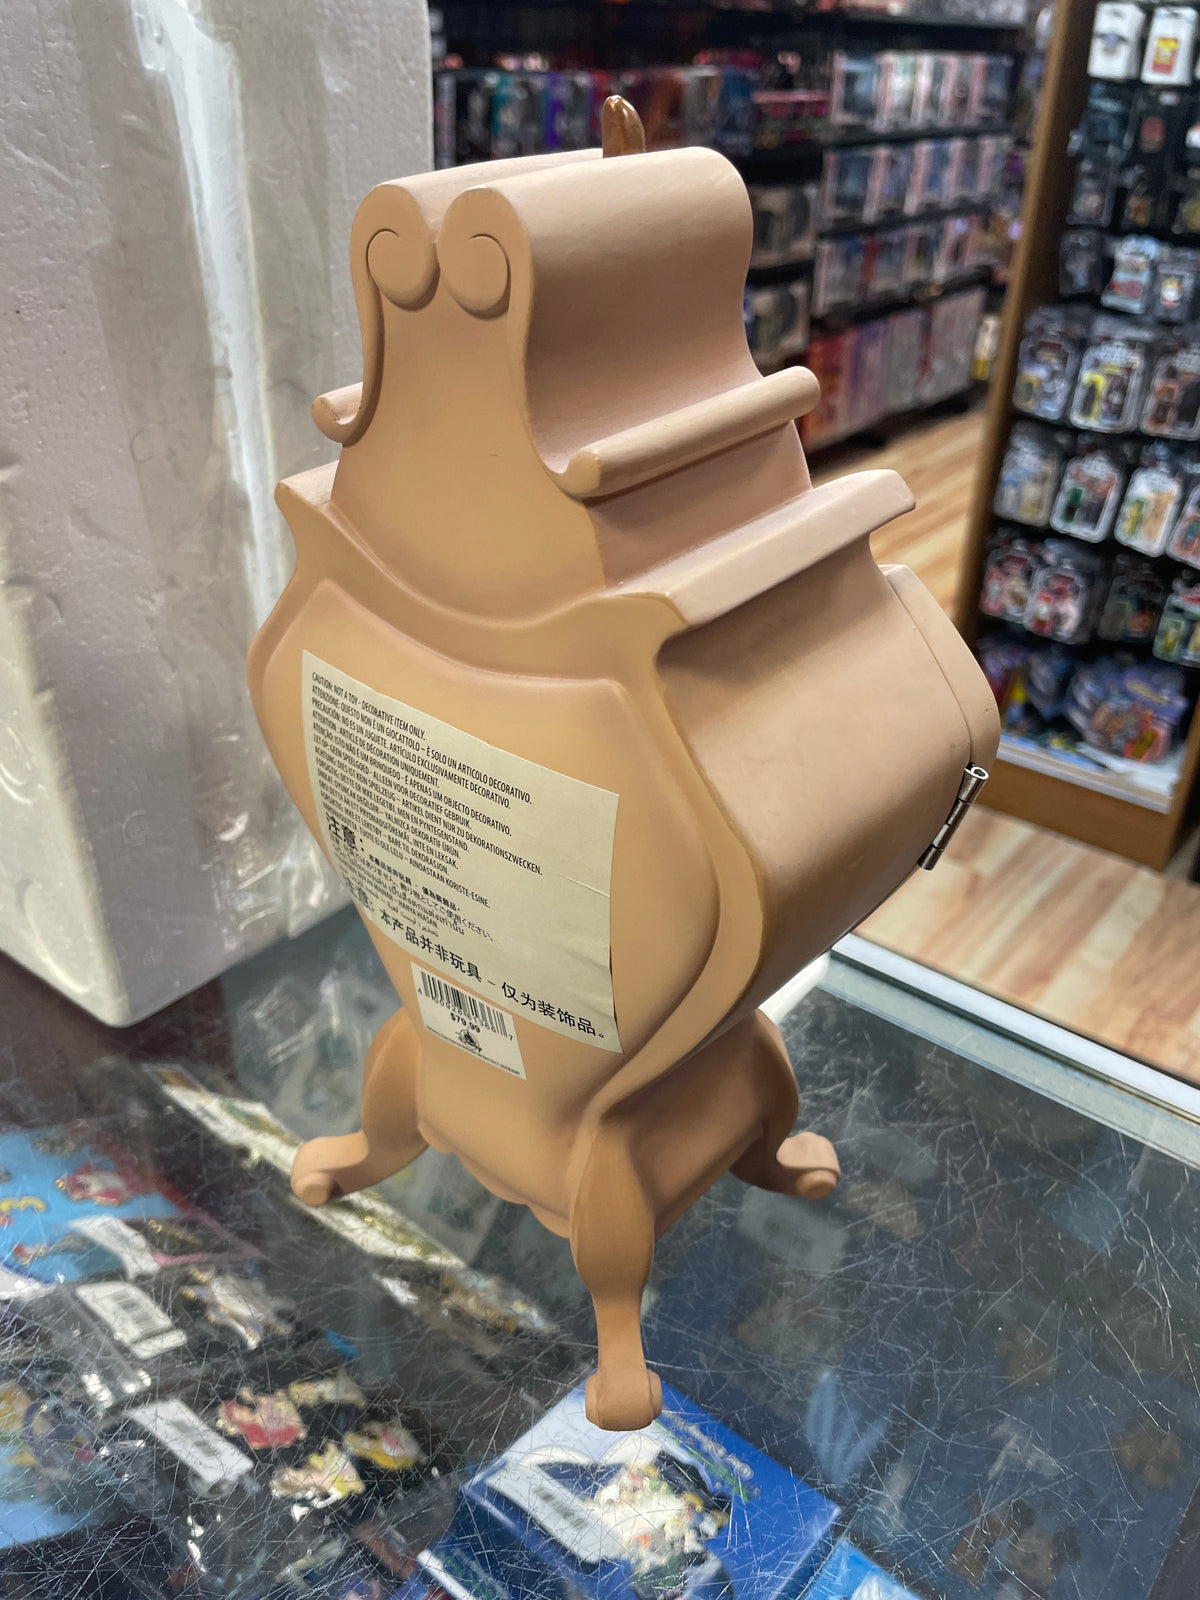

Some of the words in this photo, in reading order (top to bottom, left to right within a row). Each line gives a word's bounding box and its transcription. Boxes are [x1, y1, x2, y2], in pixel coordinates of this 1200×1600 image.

[312, 670, 332, 691] CAUTION:
[334, 683, 343, 697] NOT
[348, 692, 358, 706] TOY
[361, 699, 393, 726] DECORATIVE
[394, 716, 408, 733] ITEM
[408, 723, 425, 740] ONLY.
[312, 683, 339, 709] ATTENZIONE:
[340, 701, 359, 720] QUESTO
[360, 712, 371, 727] NON
[376, 720, 384, 734] UN
[385, 725, 419, 752] GIOCATTOLO
[426, 744, 430, 757] È
[431, 748, 446, 765] SOLO
[447, 756, 456, 770] UN
[457, 760, 487, 784] ARTICOLO
[488, 775, 531, 804] DECORATIVO.
[312, 709, 336, 731] ATTENTION
[339, 725, 358, 745] ARTICLE
[358, 737, 365, 749] DE
[366, 739, 399, 768] DÉCORATION
[400, 759, 439, 788] UNIQUEMENT.
[329, 743, 341, 758] GEEN
[342, 751, 369, 775] SPEELGOED
[373, 770, 392, 788] ALLEEN
[392, 781, 408, 798] VOOR
[409, 789, 442, 814] DECORATIEF
[444, 807, 471, 830] GEBRUIK.
[334, 734, 345, 749] ISTO
[345, 739, 355, 755] NÃO
[360, 751, 368, 763] UM
[369, 756, 400, 781] BRINQUEDO
[405, 774, 408, 785] É
[409, 777, 431, 797] APENAS
[432, 789, 442, 802] UM
[443, 795, 469, 816] OBJECTO
[470, 807, 511, 837] DECORATIVO.
[341, 714, 348, 726] NO
[349, 719, 355, 730] ES
[356, 723, 363, 735] UN
[364, 727, 387, 748] JUGUETE.
[389, 739, 416, 764] ARTÍCULO
[417, 755, 468, 789] EXCLUSIVAMENTE
[469, 781, 510, 809] DECORATIVO.
[329, 786, 342, 801] DETTA
[350, 800, 358, 811] ETT
[412, 837, 425, 852] INTE
[426, 845, 433, 856] EN
[434, 849, 458, 869] LEKSAK.
[337, 759, 348, 773] DIES
[356, 771, 367, 785] KEIN
[368, 778, 395, 802] SPIELZEUG
[401, 797, 424, 817] ARTIKEL
[425, 809, 441, 826] DIENT
[442, 818, 455, 833] NUR
[456, 826, 464, 838] ZU
[465, 830, 542, 876] DEKORATIONSZWECKEN.
[340, 772, 354, 788] DETTE
[355, 782, 361, 792] ER
[362, 786, 372, 800] IKKE
[397, 806, 409, 821] MEN
[410, 814, 418, 825] EN
[419, 818, 469, 853] PYNTEGENSTAND.
[344, 806, 354, 820] IKKE
[355, 813, 360, 824] ET
[388, 833, 401, 849] BARE
[401, 841, 410, 854] TIL
[411, 847, 449, 875] DEKORASJON.
[442, 840, 460, 859] ÜRÜN.
[374, 836, 379, 845] EI
[380, 839, 389, 852] OLE
[390, 846, 403, 861] LELU
[409, 856, 444, 883] AINOASTAAN
[445, 876, 490, 909] KORISTE-ESINE.
[379, 907, 481, 983] 本产品并非玩具
[501, 980, 604, 1040] 仅为装饰品。
[450, 1012, 480, 1034] $79.99
